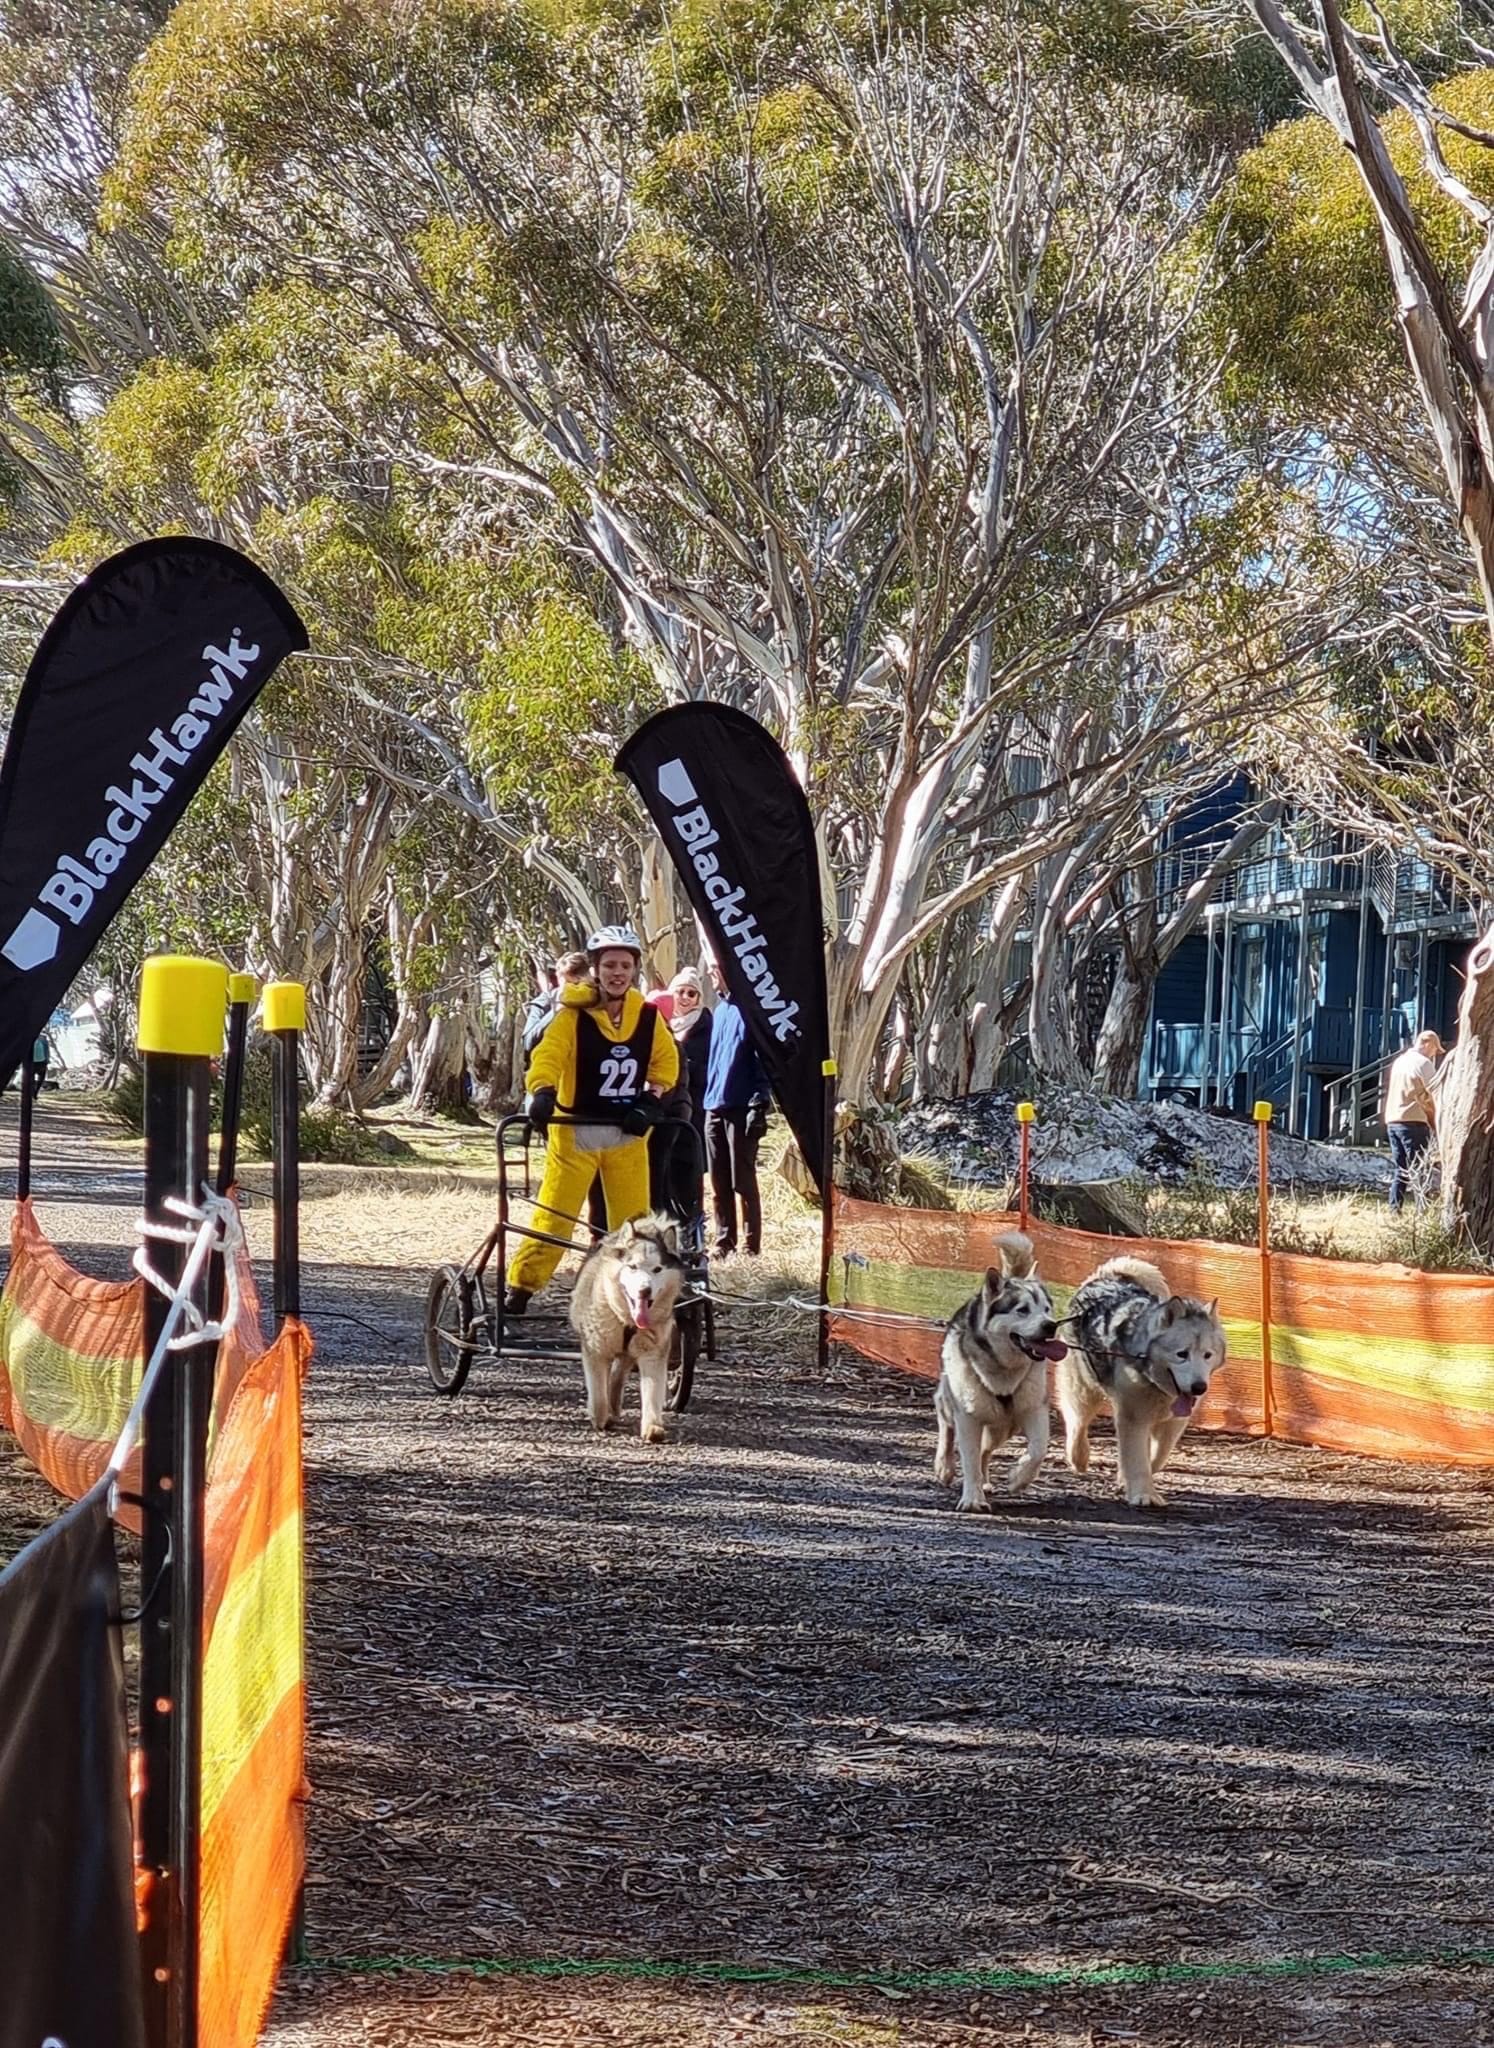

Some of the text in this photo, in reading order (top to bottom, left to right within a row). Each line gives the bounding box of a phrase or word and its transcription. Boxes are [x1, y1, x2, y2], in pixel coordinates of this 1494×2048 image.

[39, 632, 260, 925] BlackHawk
[672, 805, 800, 1042] BlackHawk
[599, 1058, 638, 1097] 22
